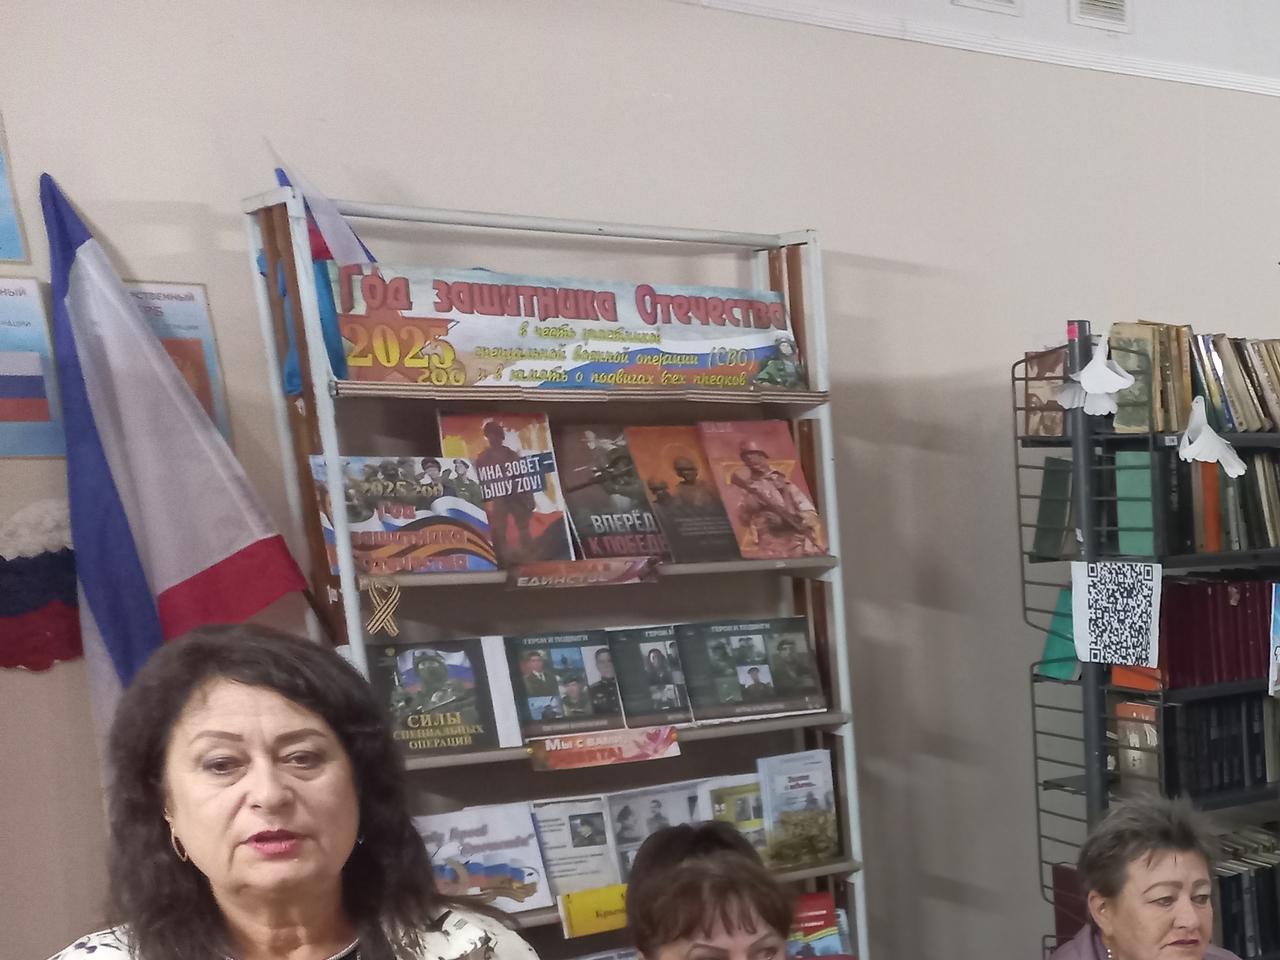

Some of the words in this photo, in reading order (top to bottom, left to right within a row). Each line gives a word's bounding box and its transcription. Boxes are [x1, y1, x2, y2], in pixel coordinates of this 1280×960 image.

[433, 279, 618, 322] защитника
[635, 284, 788, 331] Отечества
[341, 323, 456, 368] 2025
[573, 347, 629, 364] военной
[636, 352, 699, 368] операции
[707, 348, 757, 371] (СВО)
[590, 370, 654, 384] подвигах
[661, 371, 687, 385] всех
[693, 372, 747, 387] предков
[505, 456, 542, 478] ЗОВЁТ
[358, 480, 408, 498] 2025
[481, 481, 512, 499] ЫШУ
[407, 711, 462, 729] СИЛЫ
[409, 734, 473, 750] ОПЕРАЦИЙ
[545, 738, 573, 751] Мы
[577, 740, 584, 748] с
